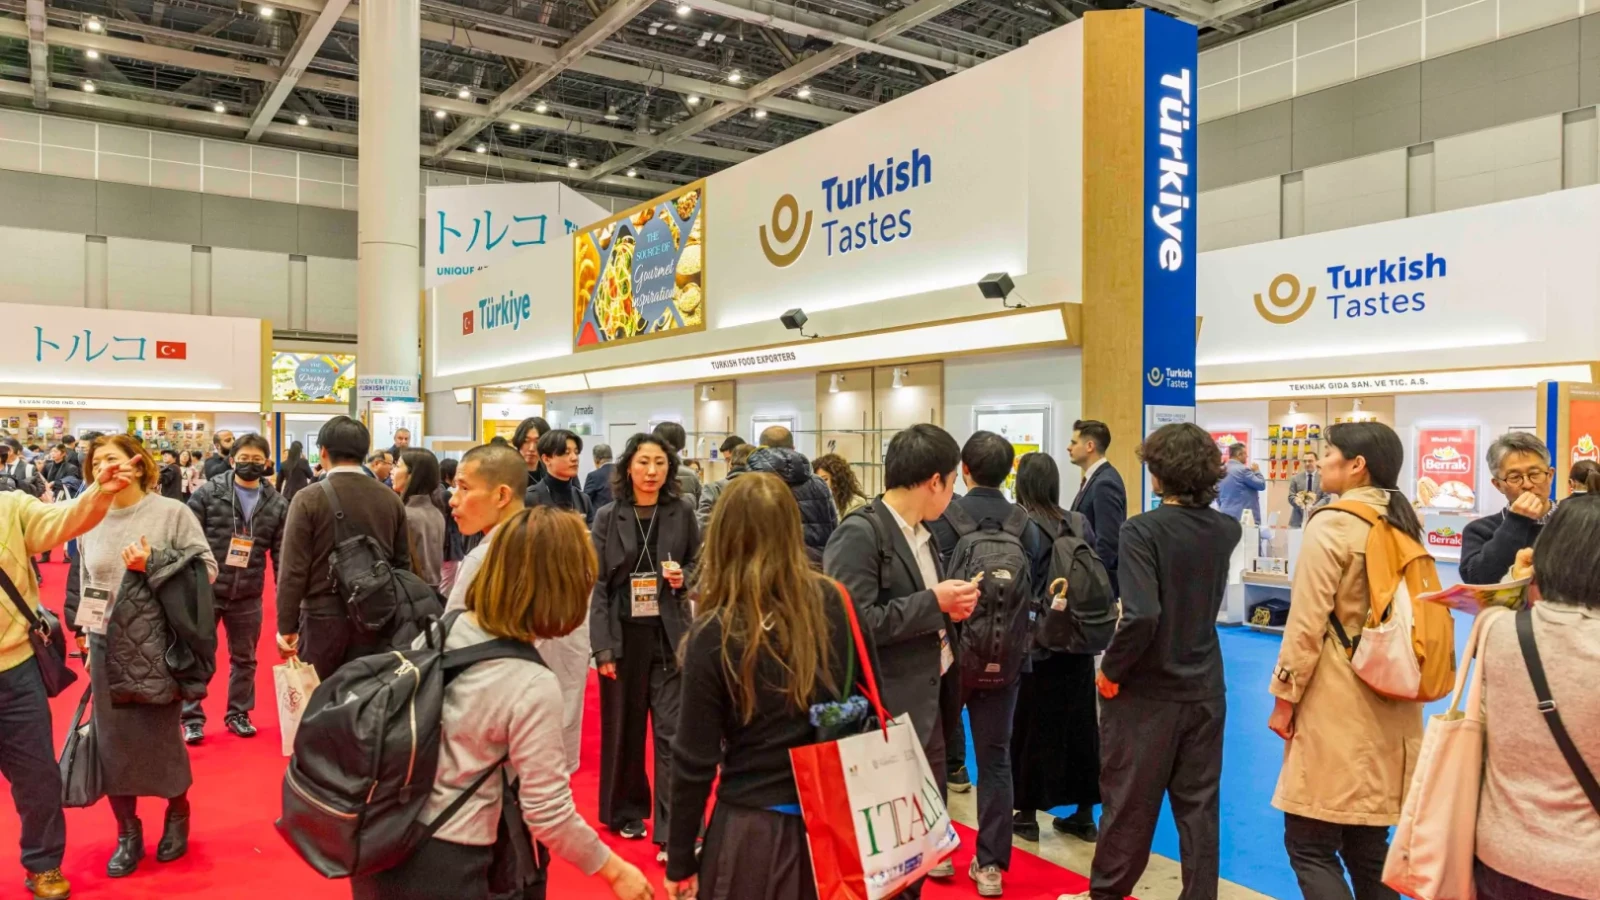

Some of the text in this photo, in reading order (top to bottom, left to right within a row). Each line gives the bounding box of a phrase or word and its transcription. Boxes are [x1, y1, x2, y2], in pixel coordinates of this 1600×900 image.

[821, 148, 932, 213] Turkish
[1152, 69, 1190, 271] Türkiye
[437, 210, 548, 255] トルコ
[646, 231, 659, 242] THE
[821, 208, 912, 256] Tastes
[636, 241, 671, 261] SOURCE OF
[633, 259, 675, 293] Gourmet
[1326, 252, 1447, 290] Turkish
[478, 290, 530, 330] Türkiye
[1326, 292, 1426, 319] Tastes
[33, 326, 147, 363] トルコ
[711, 352, 796, 369] TURKISH FOOD EXPORTERS
[1166, 367, 1193, 378] Turkish
[1166, 378, 1189, 389] Tastes
[1289, 383, 1326, 391] TEKINAK
[1351, 380, 1372, 388] SAN.
[1374, 379, 1387, 387] VE
[574, 405, 594, 416] Armada
[1425, 458, 1468, 470] Berrak
[1430, 534, 1462, 545] Berrak
